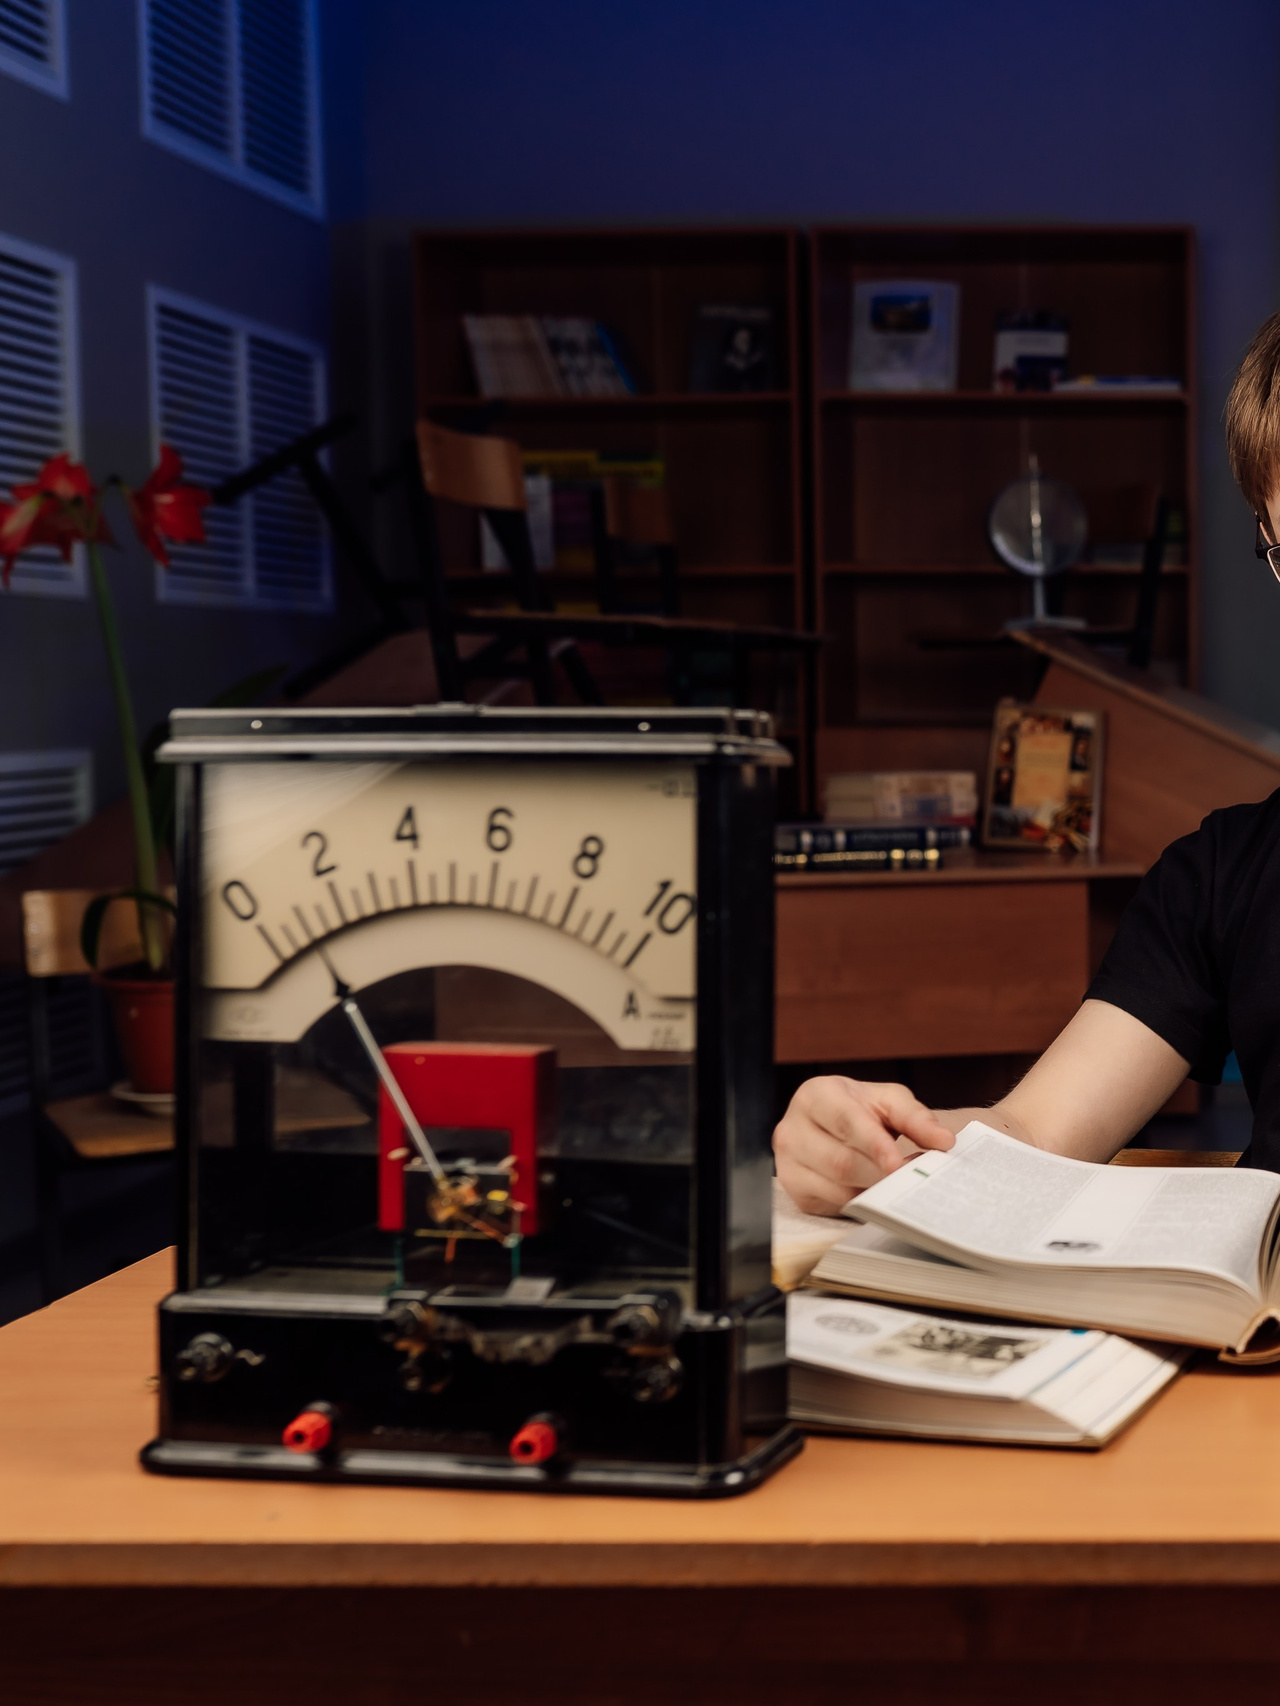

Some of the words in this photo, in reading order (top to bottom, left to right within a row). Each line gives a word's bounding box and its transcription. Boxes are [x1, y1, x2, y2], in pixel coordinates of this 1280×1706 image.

[220, 879, 259, 922] 0
[301, 830, 339, 878] 2
[393, 806, 420, 850] 4
[485, 806, 514, 852] 6
[572, 834, 605, 880] 8
[643, 880, 698, 935] 10
[622, 990, 641, 1020] A
